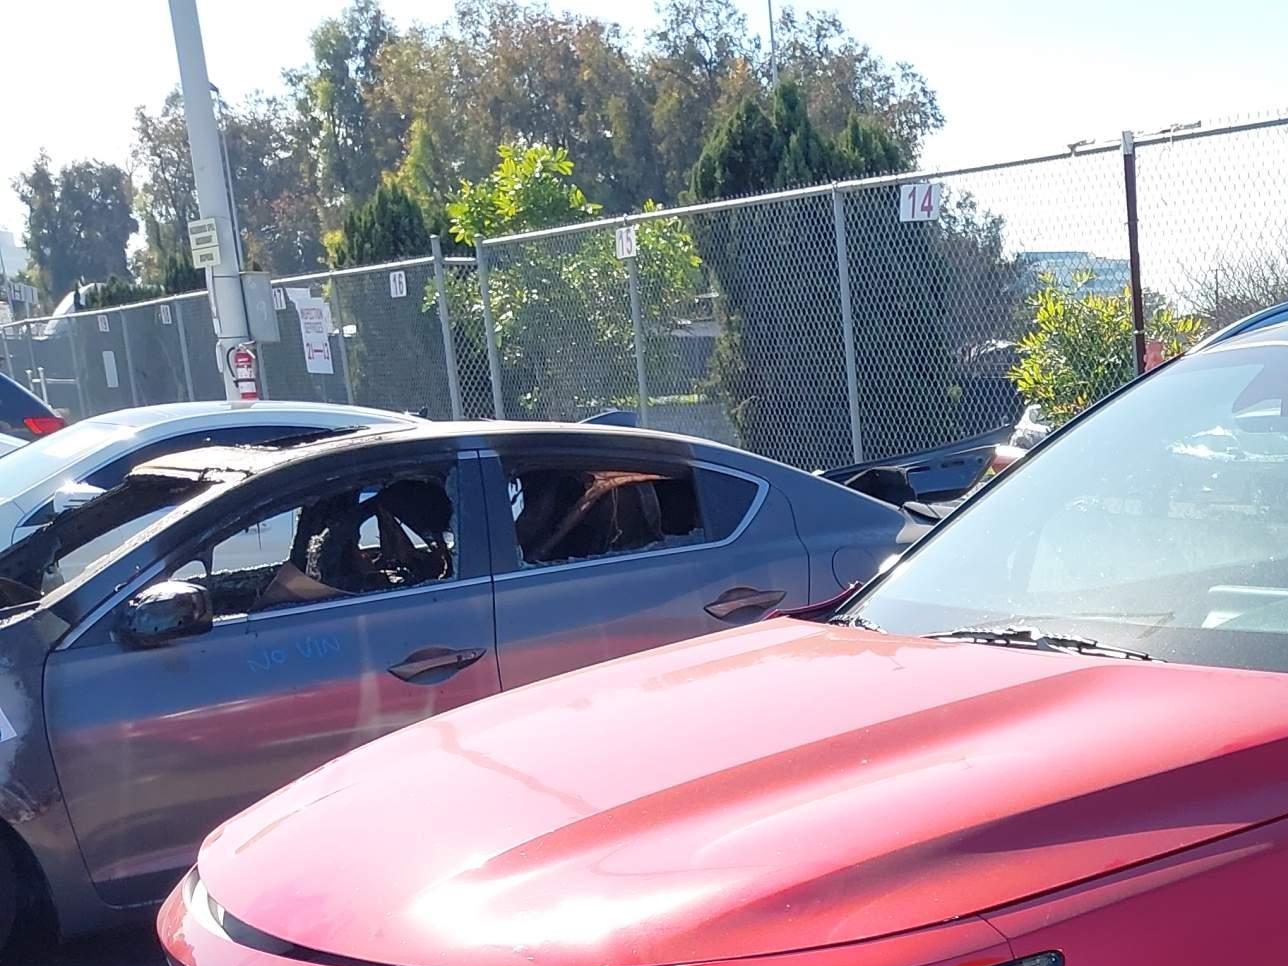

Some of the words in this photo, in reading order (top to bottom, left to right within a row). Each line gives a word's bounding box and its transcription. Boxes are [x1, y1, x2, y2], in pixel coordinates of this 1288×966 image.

[908, 185, 934, 219] 14
[618, 228, 633, 255] 15
[393, 272, 404, 296] 16
[247, 649, 286, 672] NO
[295, 634, 340, 658] VIN
